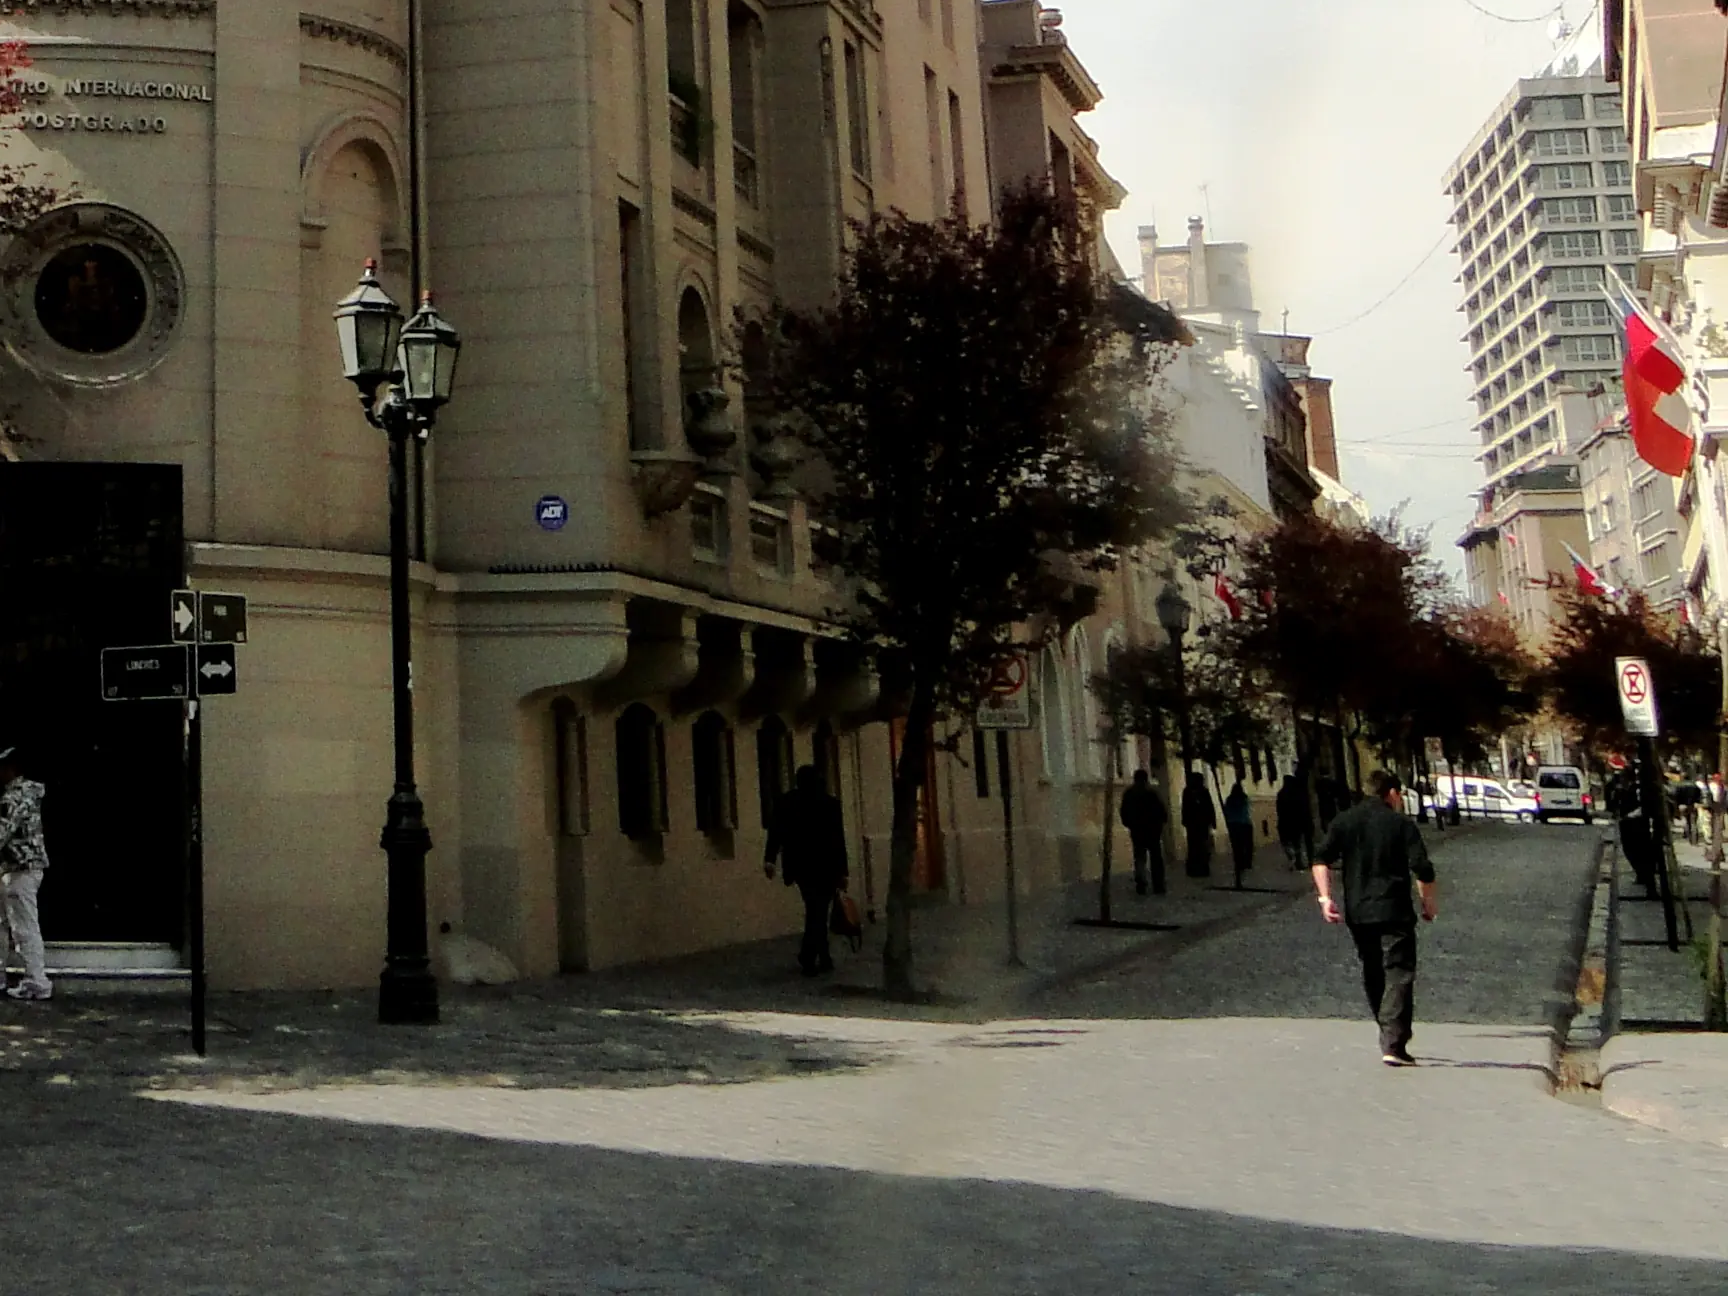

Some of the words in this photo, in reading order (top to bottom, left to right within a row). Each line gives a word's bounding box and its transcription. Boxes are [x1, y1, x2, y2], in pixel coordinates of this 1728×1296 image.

[64, 78, 213, 102] INTERNACIONAL
[20, 111, 168, 134] POSTGRADO
[541, 505, 563, 519] ADT
